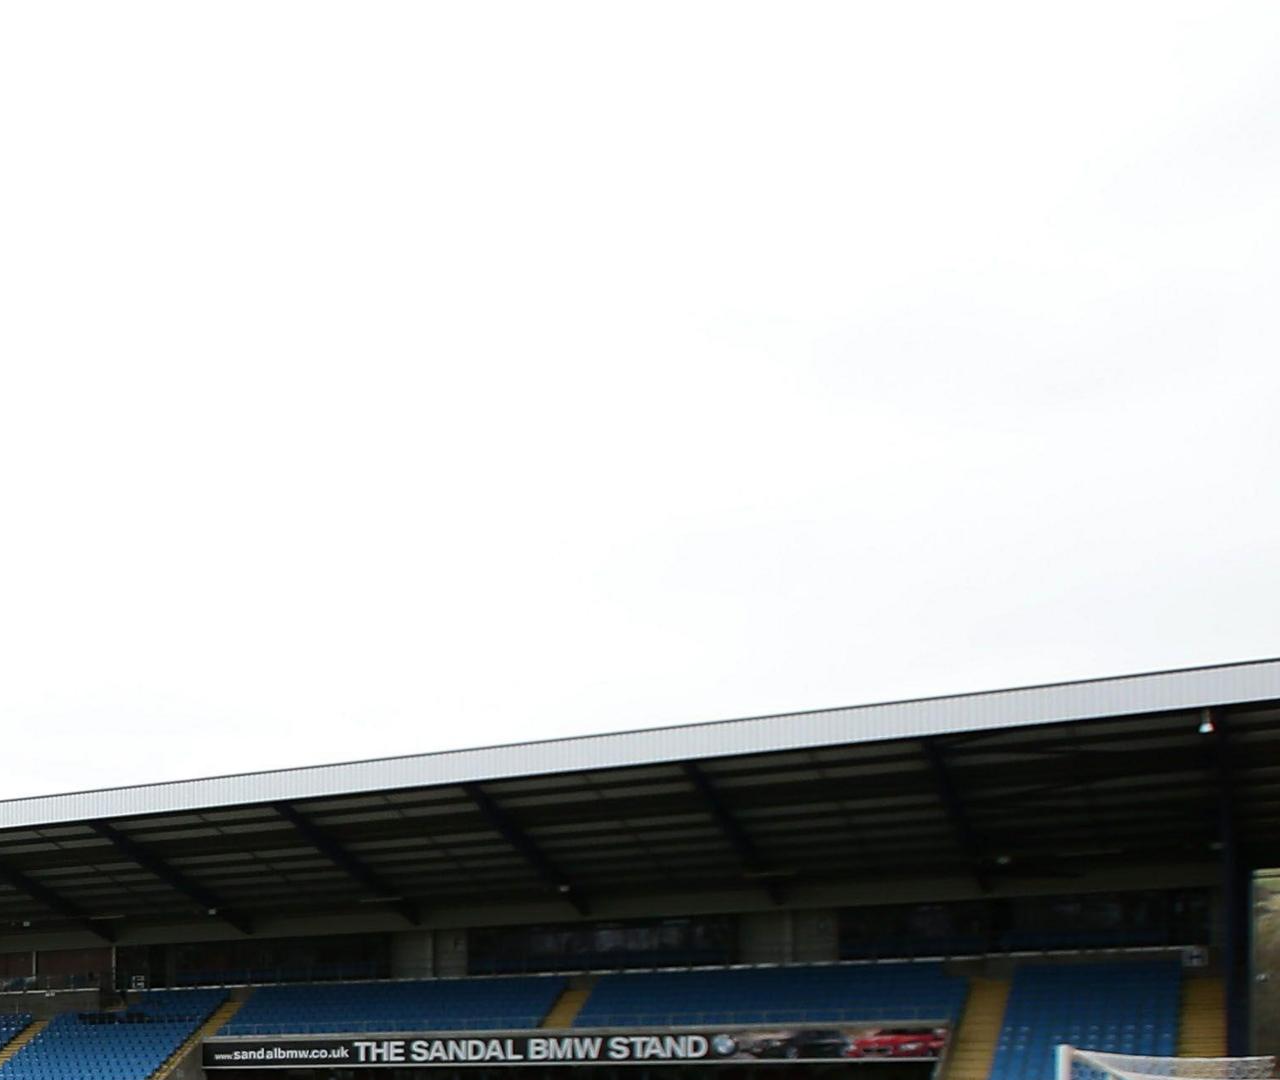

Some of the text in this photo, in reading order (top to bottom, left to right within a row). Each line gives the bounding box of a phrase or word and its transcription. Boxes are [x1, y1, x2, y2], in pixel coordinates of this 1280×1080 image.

[214, 1035, 709, 1062] www.sandalbmw.co.uk THE SANDAL BMW STAND
